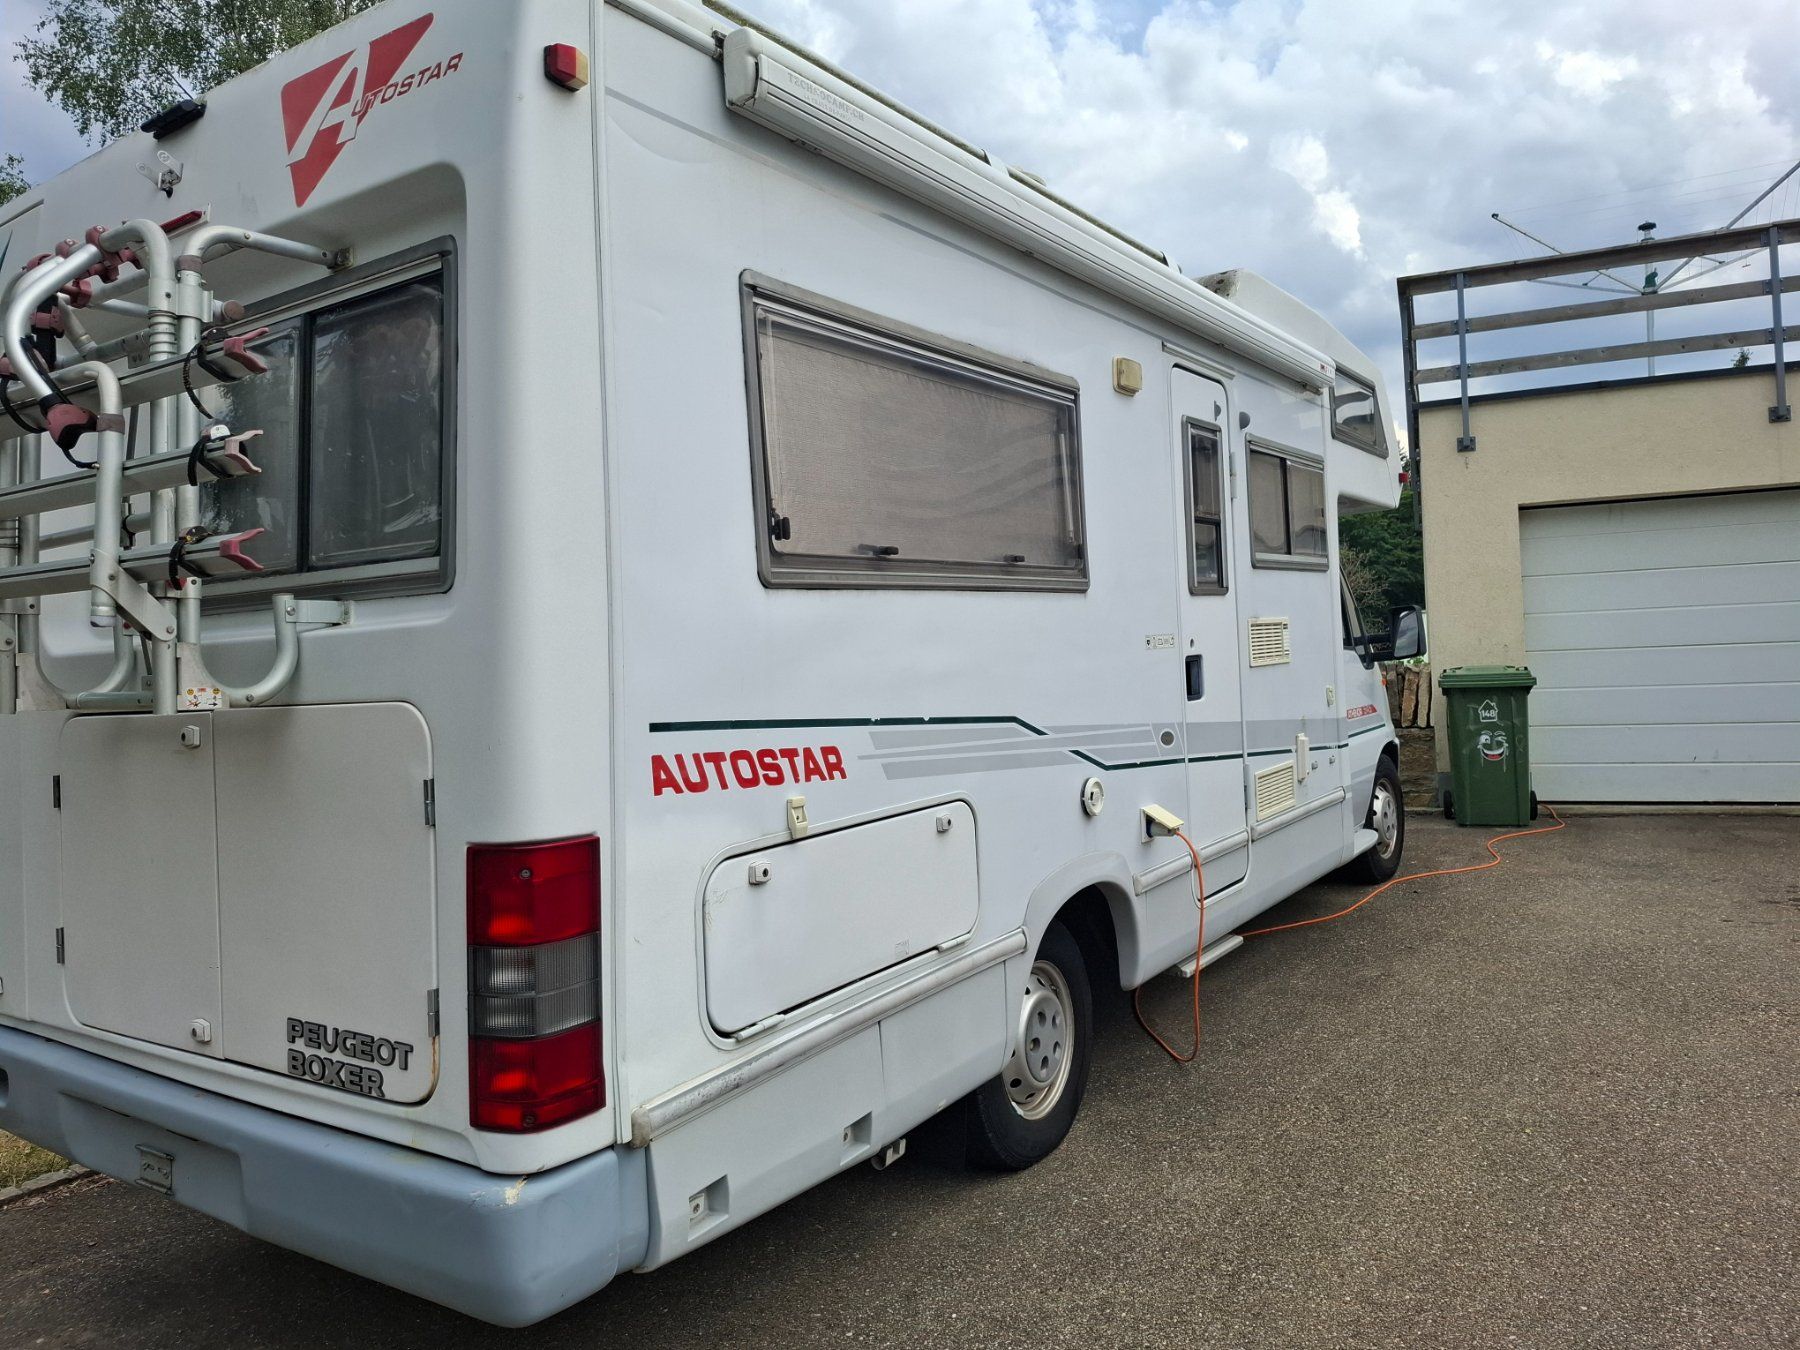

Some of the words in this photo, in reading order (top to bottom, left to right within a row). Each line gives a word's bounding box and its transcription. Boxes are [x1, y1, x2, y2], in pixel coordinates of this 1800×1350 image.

[1481, 709, 1496, 718] 148
[651, 745, 847, 796] AUTOSTAR
[286, 1017, 414, 1071] PEUGEOT
[287, 1048, 385, 1098] BOXER
